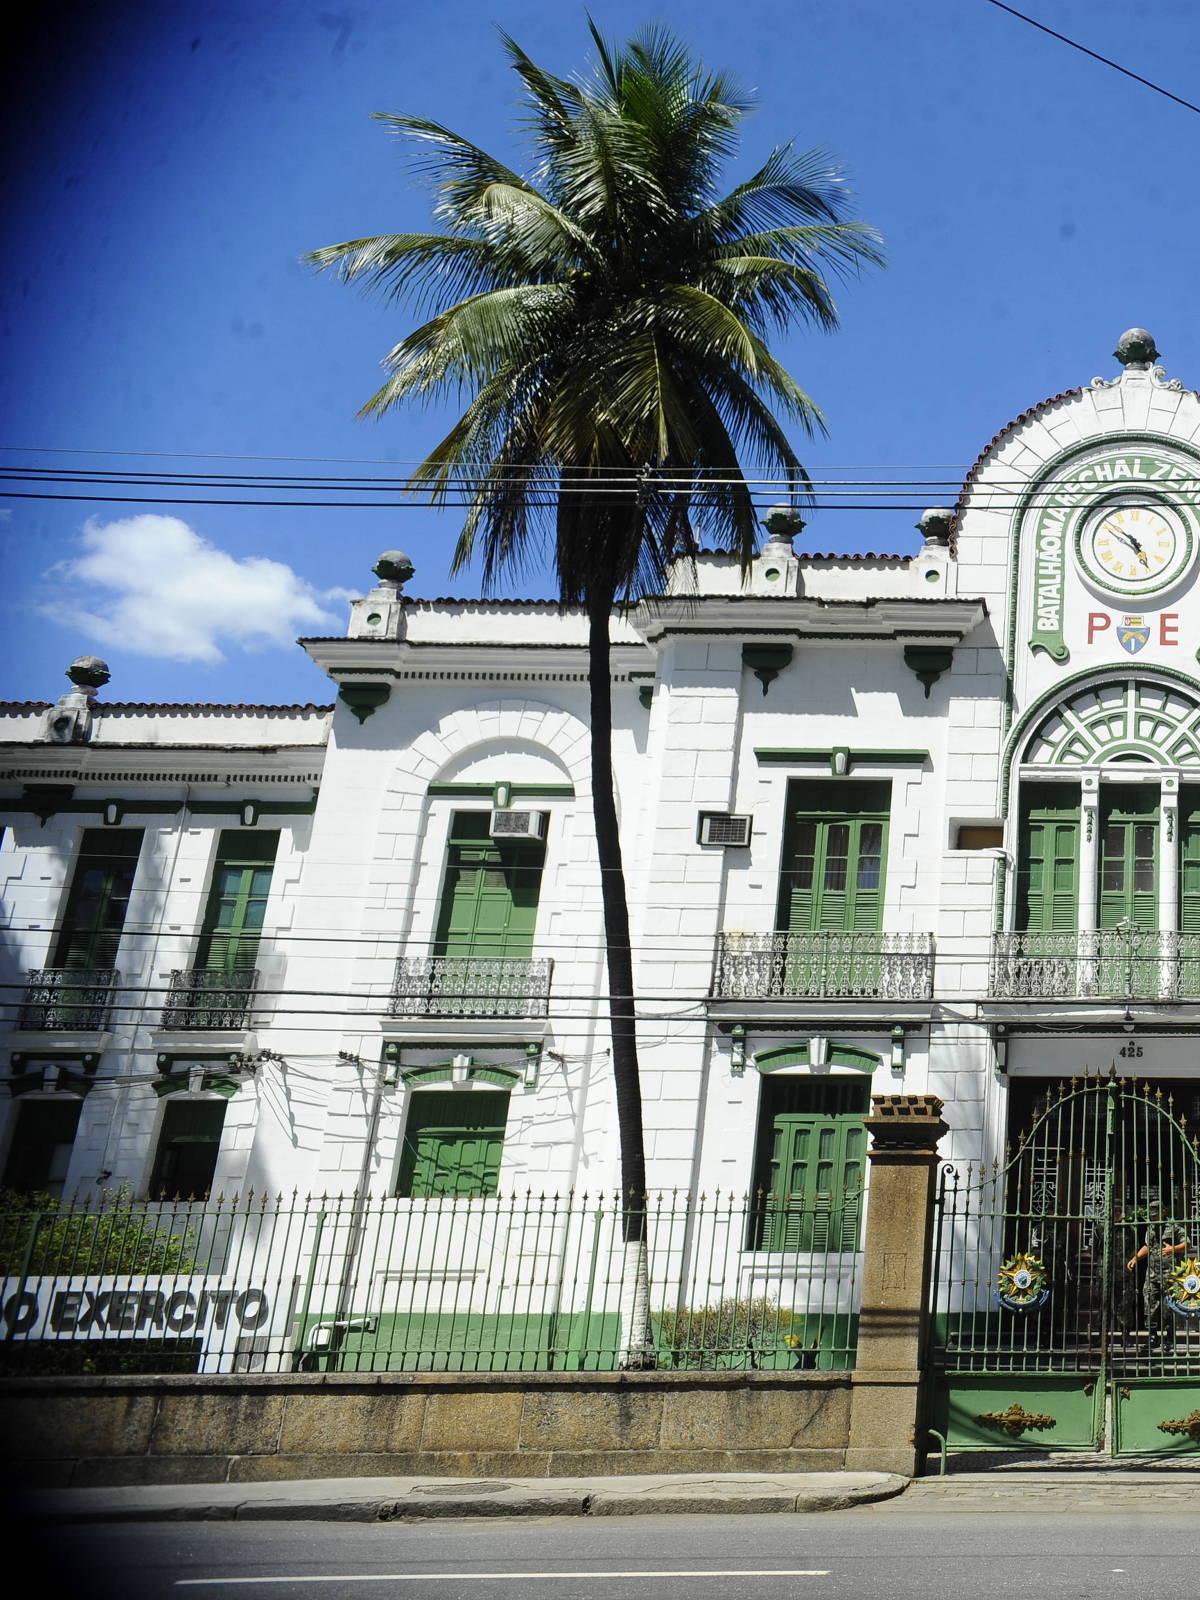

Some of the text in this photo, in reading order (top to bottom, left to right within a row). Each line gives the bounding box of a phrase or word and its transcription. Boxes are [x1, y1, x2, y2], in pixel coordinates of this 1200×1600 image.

[1087, 612, 1179, 646] P E
[1119, 1046, 1144, 1058] 425
[4, 1288, 269, 1334] O EXERCITO
